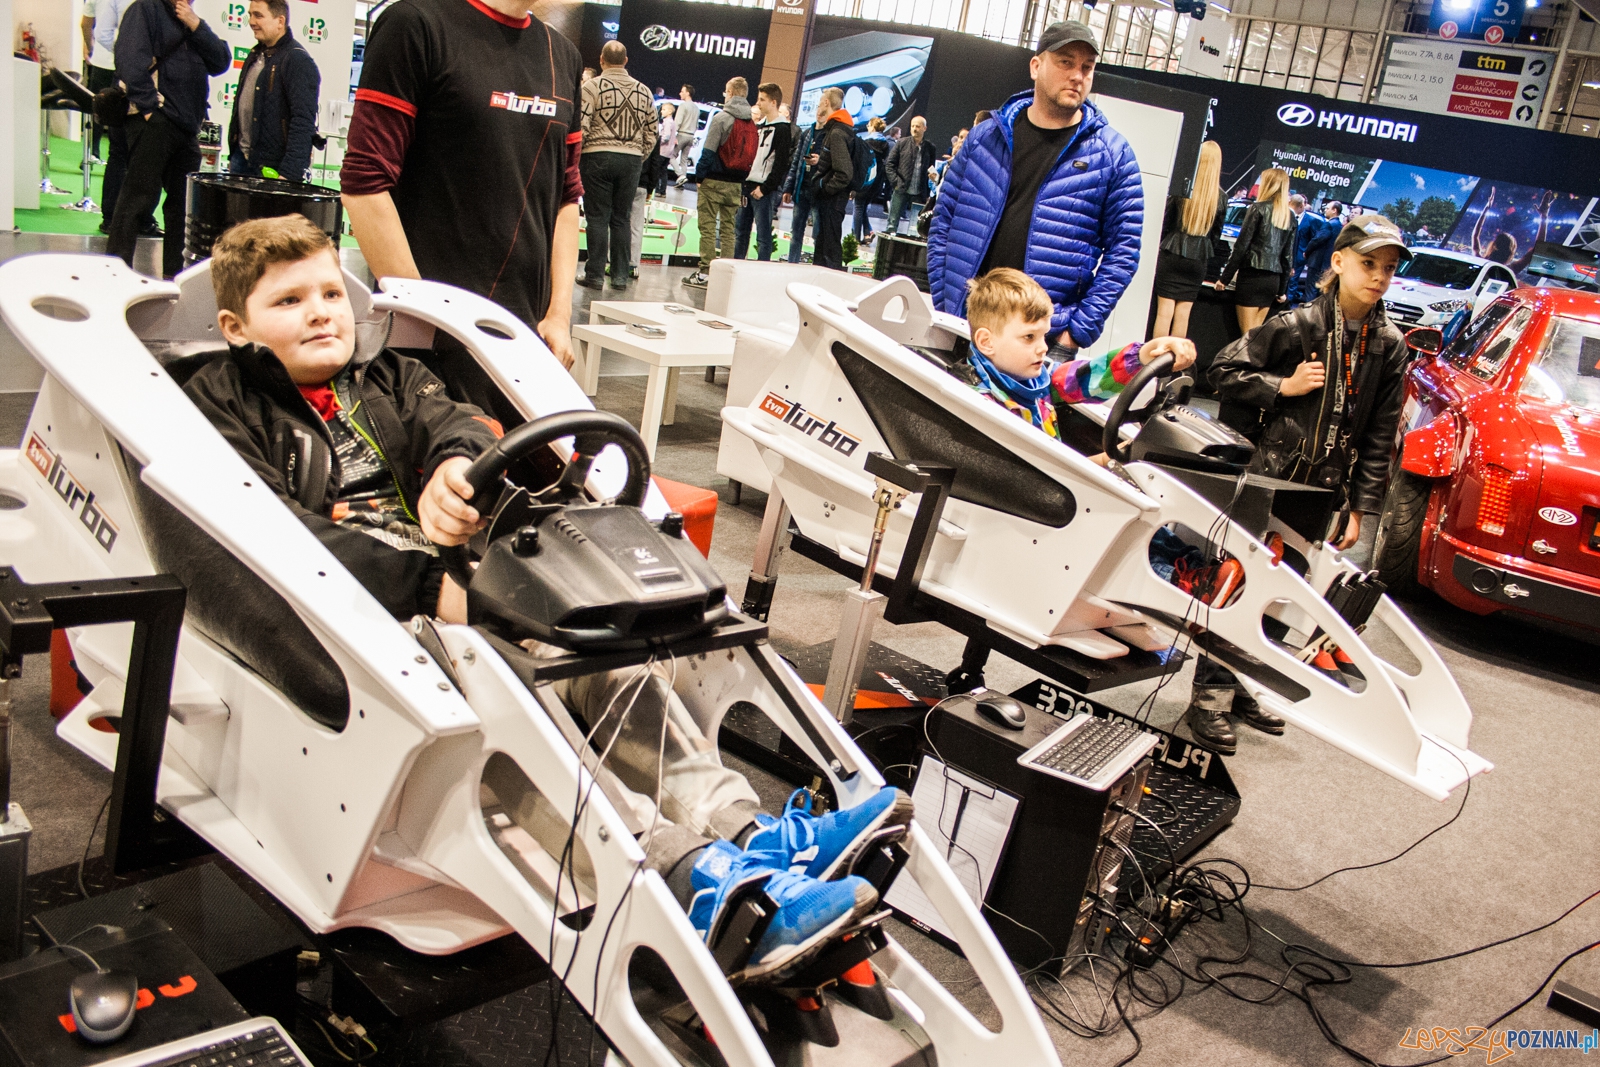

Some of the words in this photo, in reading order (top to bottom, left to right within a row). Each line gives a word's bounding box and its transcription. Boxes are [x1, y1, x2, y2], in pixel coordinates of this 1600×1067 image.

[776, 6, 804, 15] HYUNDAI
[1493, 0, 1510, 16] 5
[670, 30, 756, 60] HYUNDAI
[1477, 55, 1506, 70] ttm
[1455, 84, 1514, 96] CARAVANINGOWY
[1474, 80, 1497, 88] SALON
[1454, 104, 1504, 116] MOTOCYKLOWY
[1470, 100, 1491, 108] SALON
[1317, 110, 1418, 142] HYUNDAI
[1273, 149, 1307, 162] Hyundai.
[764, 398, 785, 415] tvn
[30, 442, 48, 470] tvn
